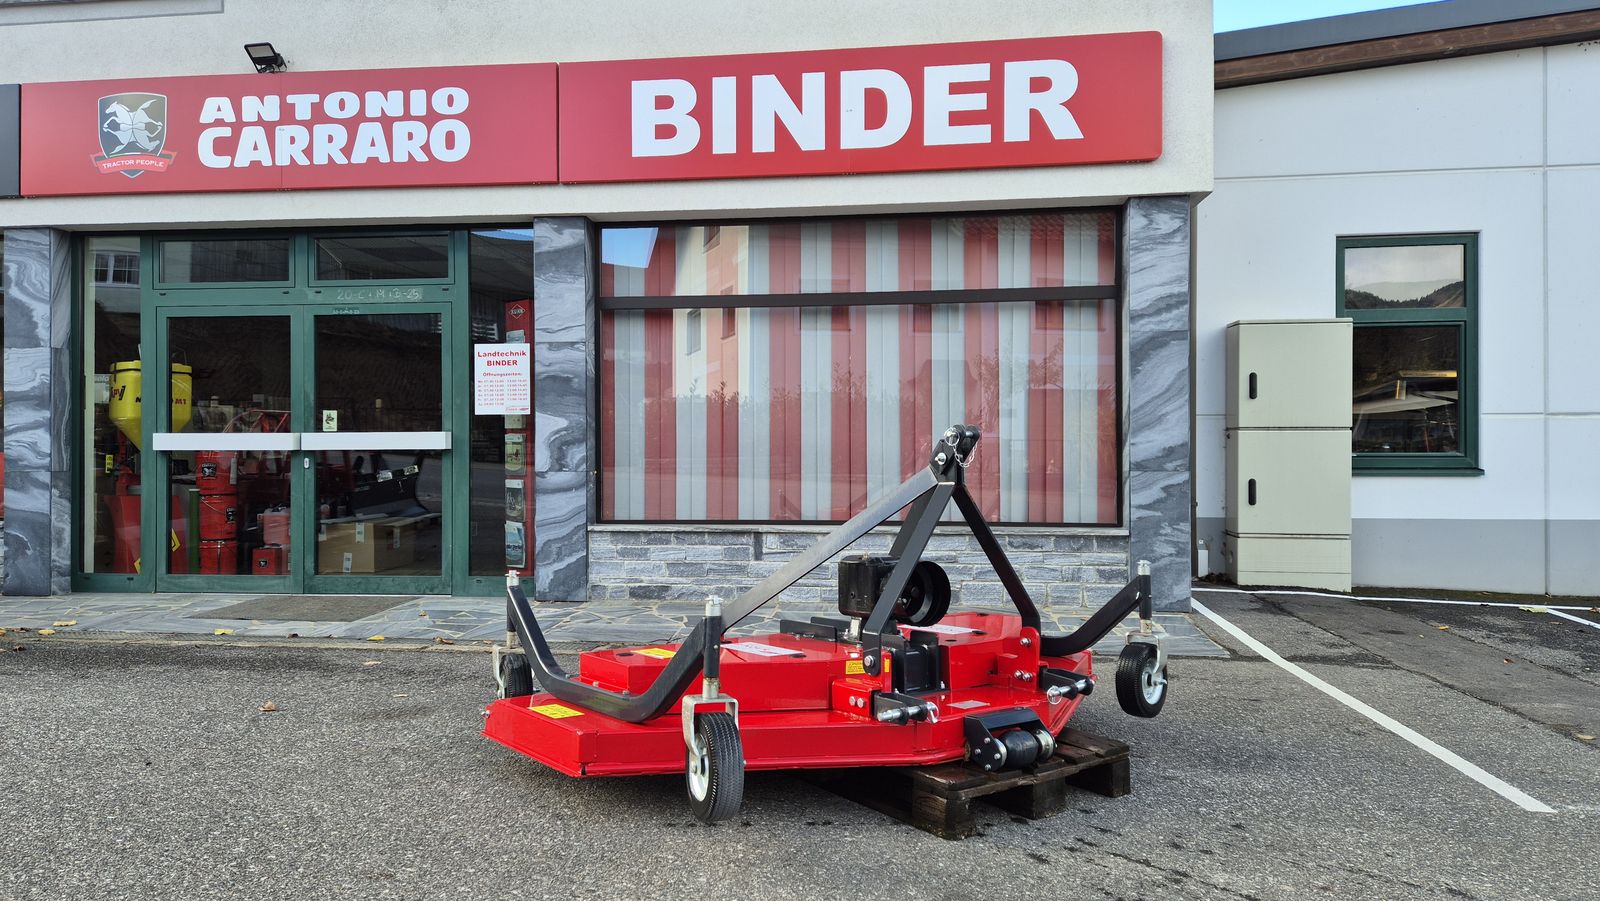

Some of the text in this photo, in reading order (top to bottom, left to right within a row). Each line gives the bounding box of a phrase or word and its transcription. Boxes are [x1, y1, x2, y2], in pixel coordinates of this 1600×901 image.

[200, 87, 470, 123] ANTONIO
[632, 60, 1083, 157] BINDER
[198, 119, 471, 168] CARRARO
[102, 159, 165, 169] TRACTOR PEOPLE
[486, 359, 518, 367] BINDER
